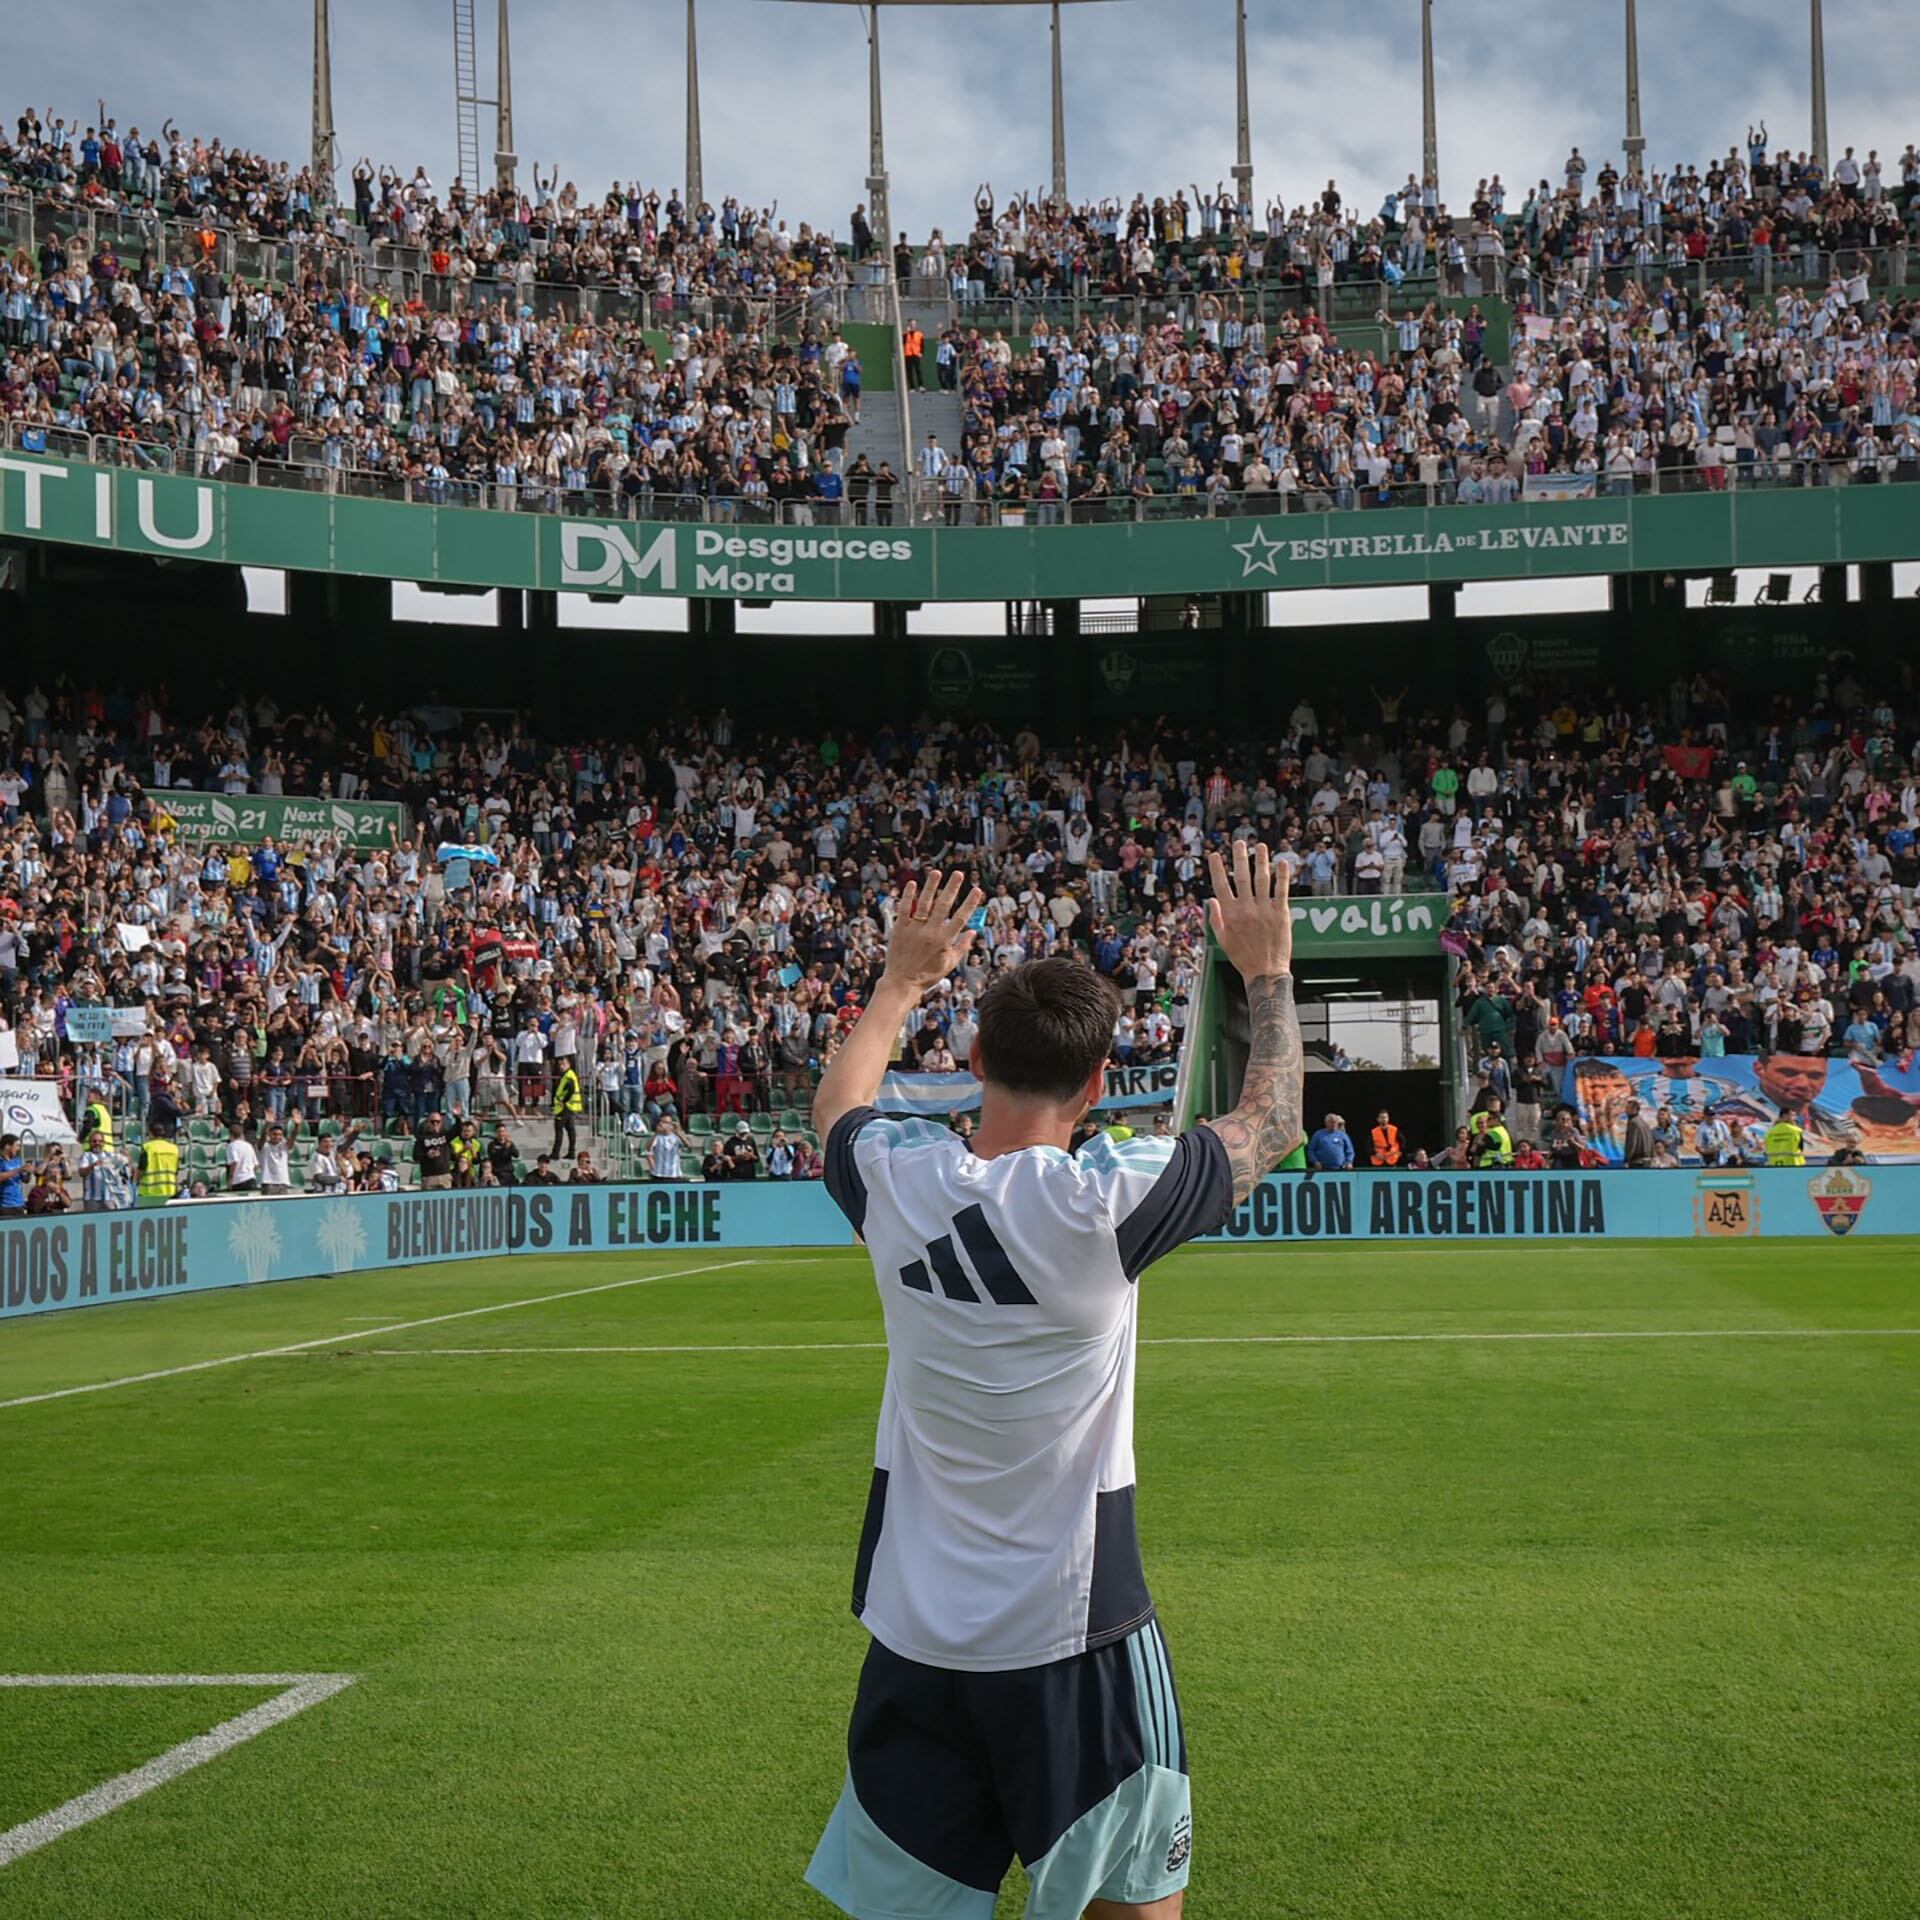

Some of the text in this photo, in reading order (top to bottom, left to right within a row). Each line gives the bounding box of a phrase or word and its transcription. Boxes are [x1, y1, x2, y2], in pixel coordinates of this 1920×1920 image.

[560, 521, 677, 590] DM
[695, 529, 912, 567] Desguaces
[1289, 523, 1629, 561] ESTRELLA DE LEVANTE
[695, 564, 795, 593] Mora
[238, 810, 267, 830] 21
[283, 805, 385, 835] Next 21
[1662, 1092, 1696, 1106] 26
[1206, 1171, 1606, 1237] CCIÓN ARGENTINA
[386, 1190, 721, 1260] BIENVENIDOS A ELCHE
[80, 1223, 98, 1297] A
[110, 1215, 188, 1293] ELCHE
